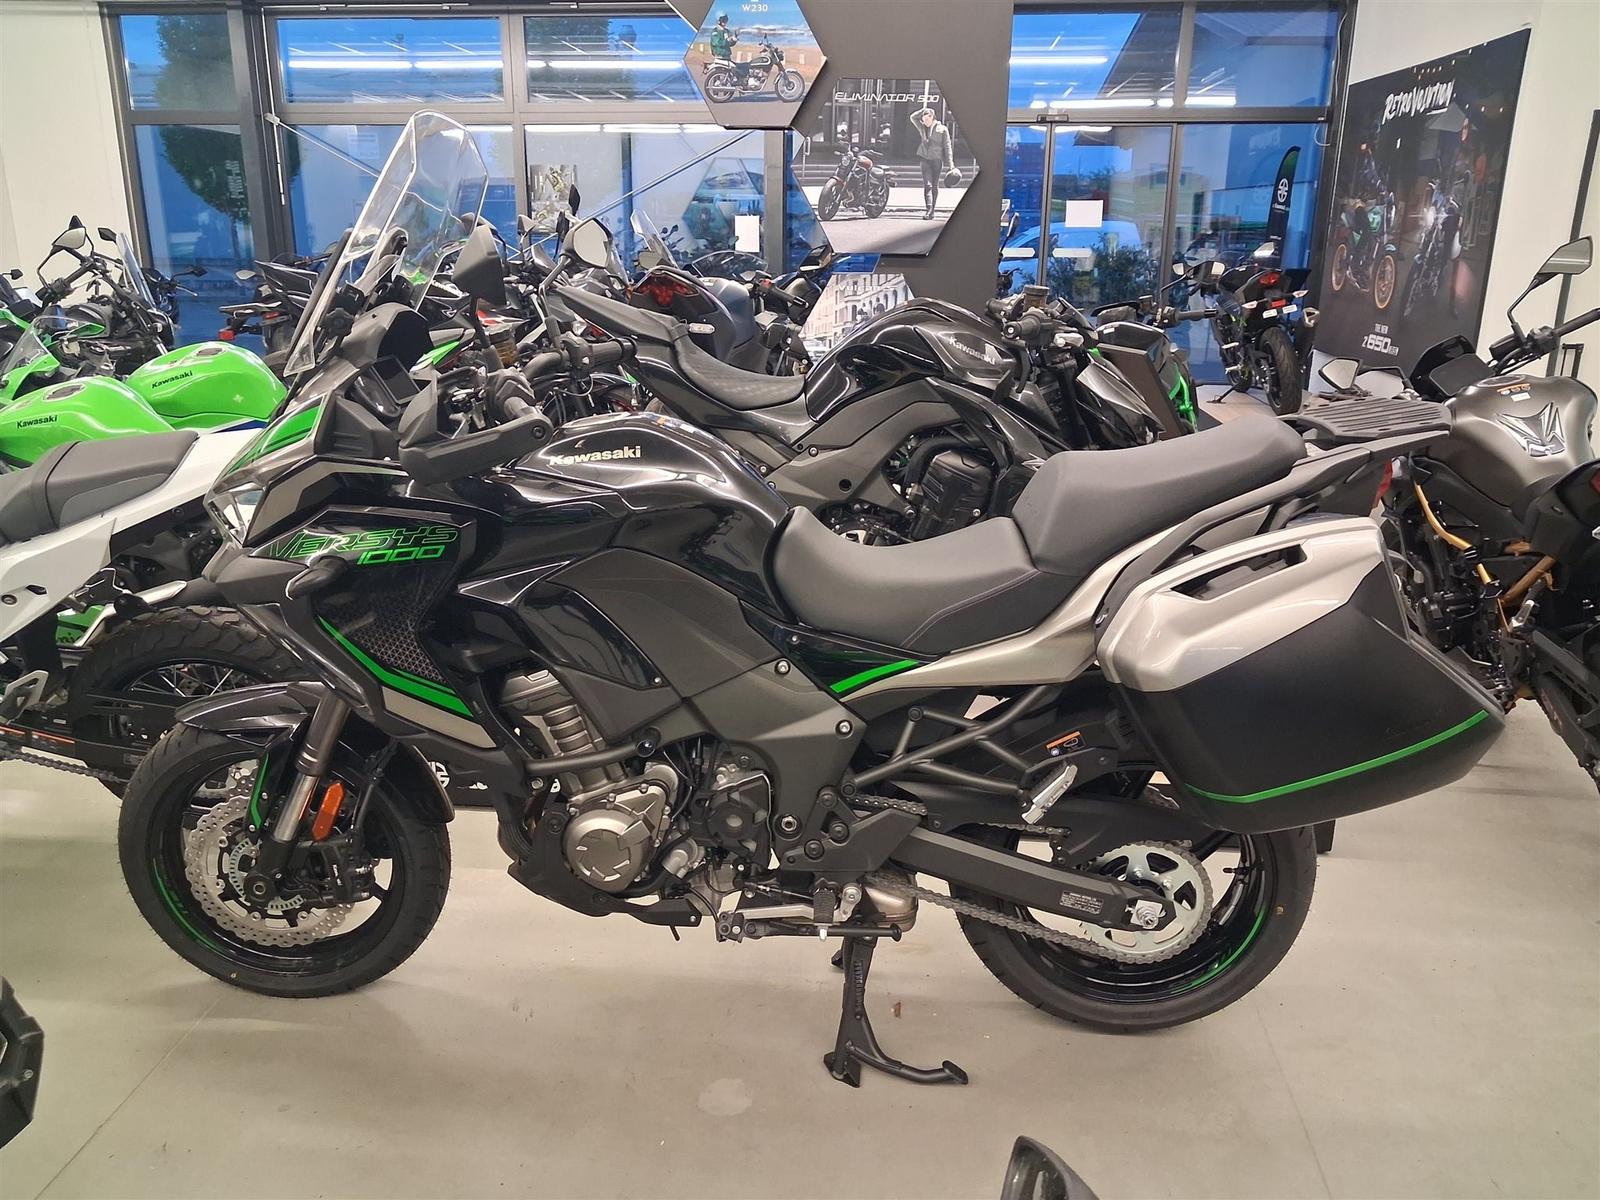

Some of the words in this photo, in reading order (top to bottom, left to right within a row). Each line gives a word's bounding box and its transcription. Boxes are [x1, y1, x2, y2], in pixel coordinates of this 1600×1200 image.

[834, 91, 916, 102] ELIMINATOR
[949, 336, 996, 365] Kawasaki
[151, 370, 193, 389] Kawasaki
[15, 414, 58, 429] Kawasaki
[549, 445, 641, 466] Kawasaki
[270, 525, 459, 559] VERSYS
[356, 544, 446, 565] 1000
